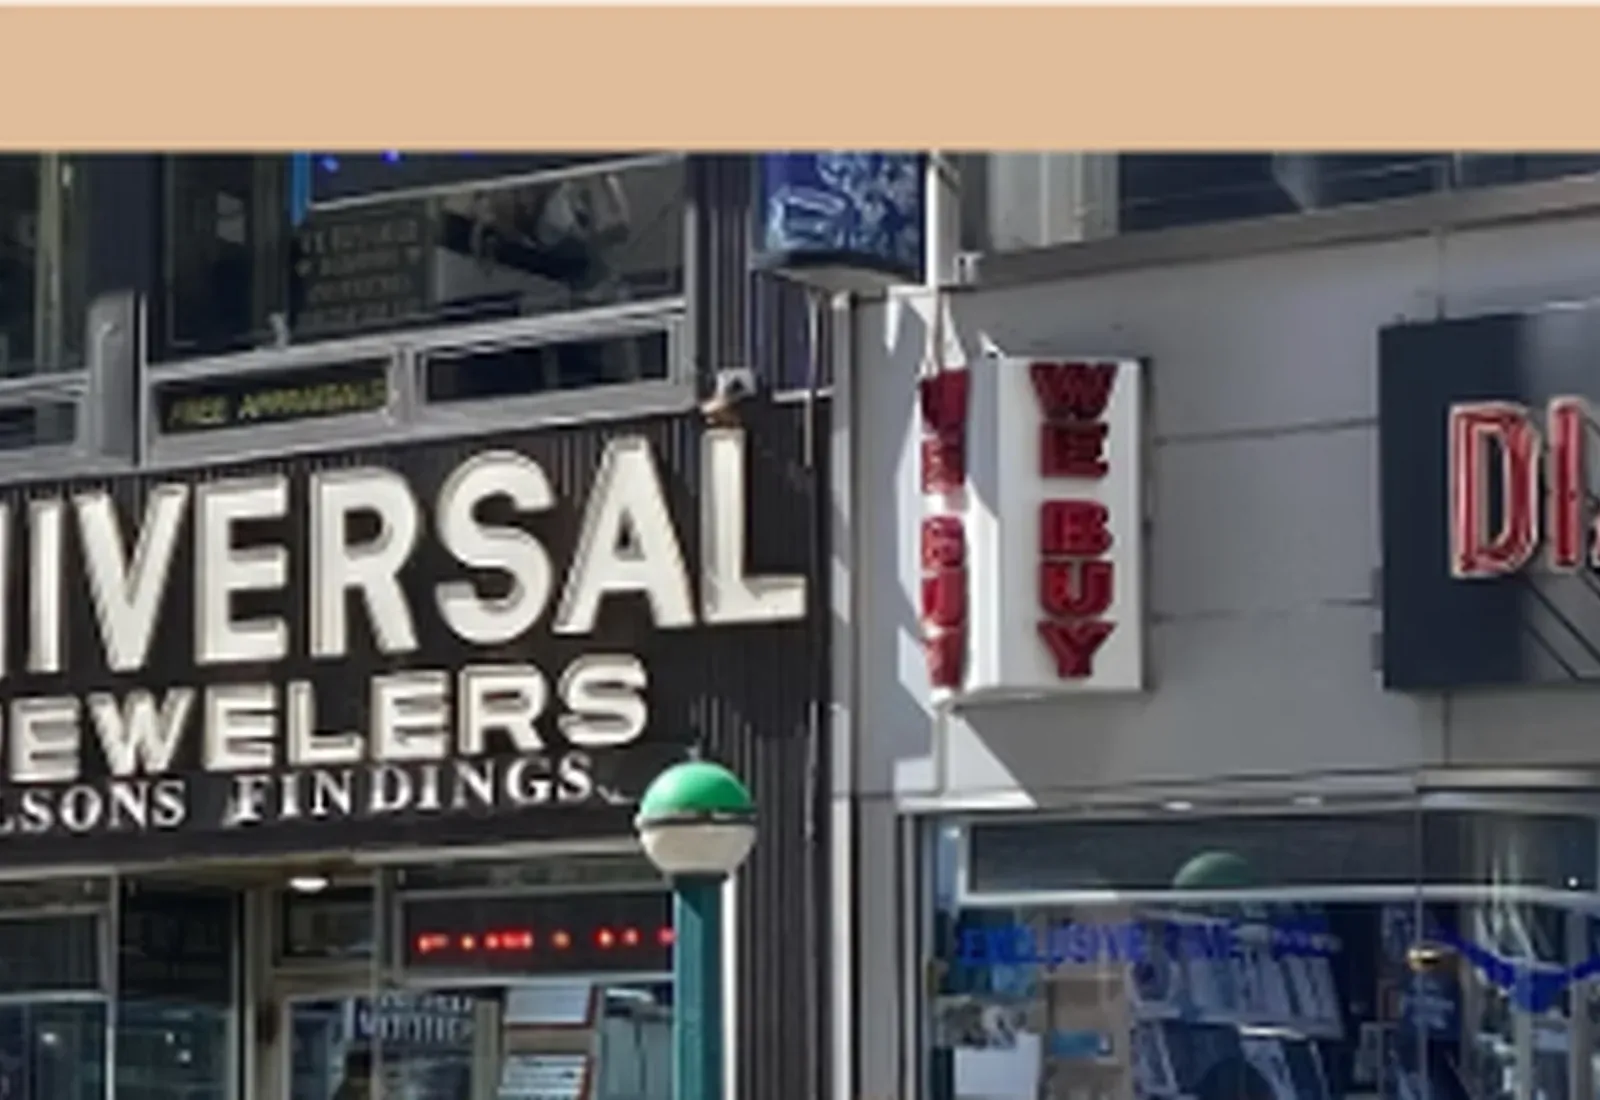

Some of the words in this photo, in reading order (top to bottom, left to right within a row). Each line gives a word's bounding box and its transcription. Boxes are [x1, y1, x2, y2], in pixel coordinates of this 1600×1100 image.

[1028, 362, 1117, 478] WE
[0, 429, 806, 677] IVERSAL
[1036, 500, 1117, 678] BUY
[0, 653, 649, 783] EWELERS
[222, 751, 594, 828] FINDINGS
